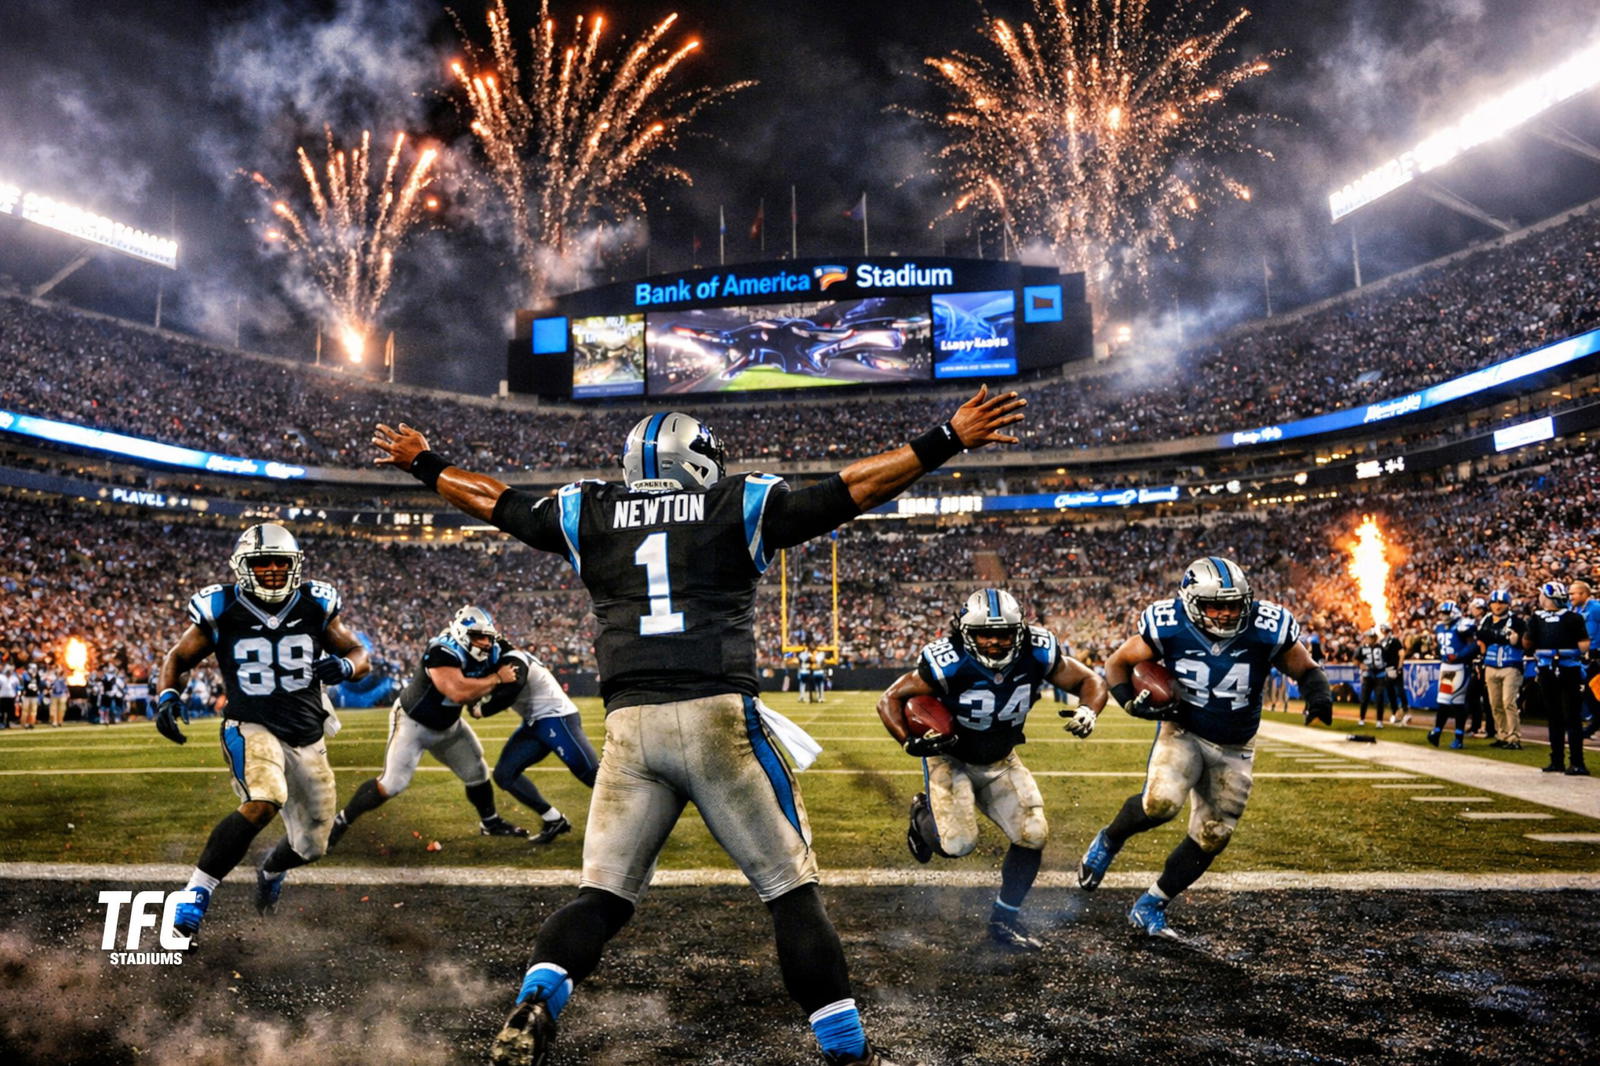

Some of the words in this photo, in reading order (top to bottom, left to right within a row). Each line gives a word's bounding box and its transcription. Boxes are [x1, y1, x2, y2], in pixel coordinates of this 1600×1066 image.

[635, 278, 692, 306] Bank
[696, 275, 720, 300] of
[722, 270, 811, 297] America
[856, 263, 953, 288] Stadium
[612, 493, 705, 529] NEWTON
[634, 532, 686, 636] 1
[956, 683, 1041, 732] 34
[1174, 658, 1252, 711] 34
